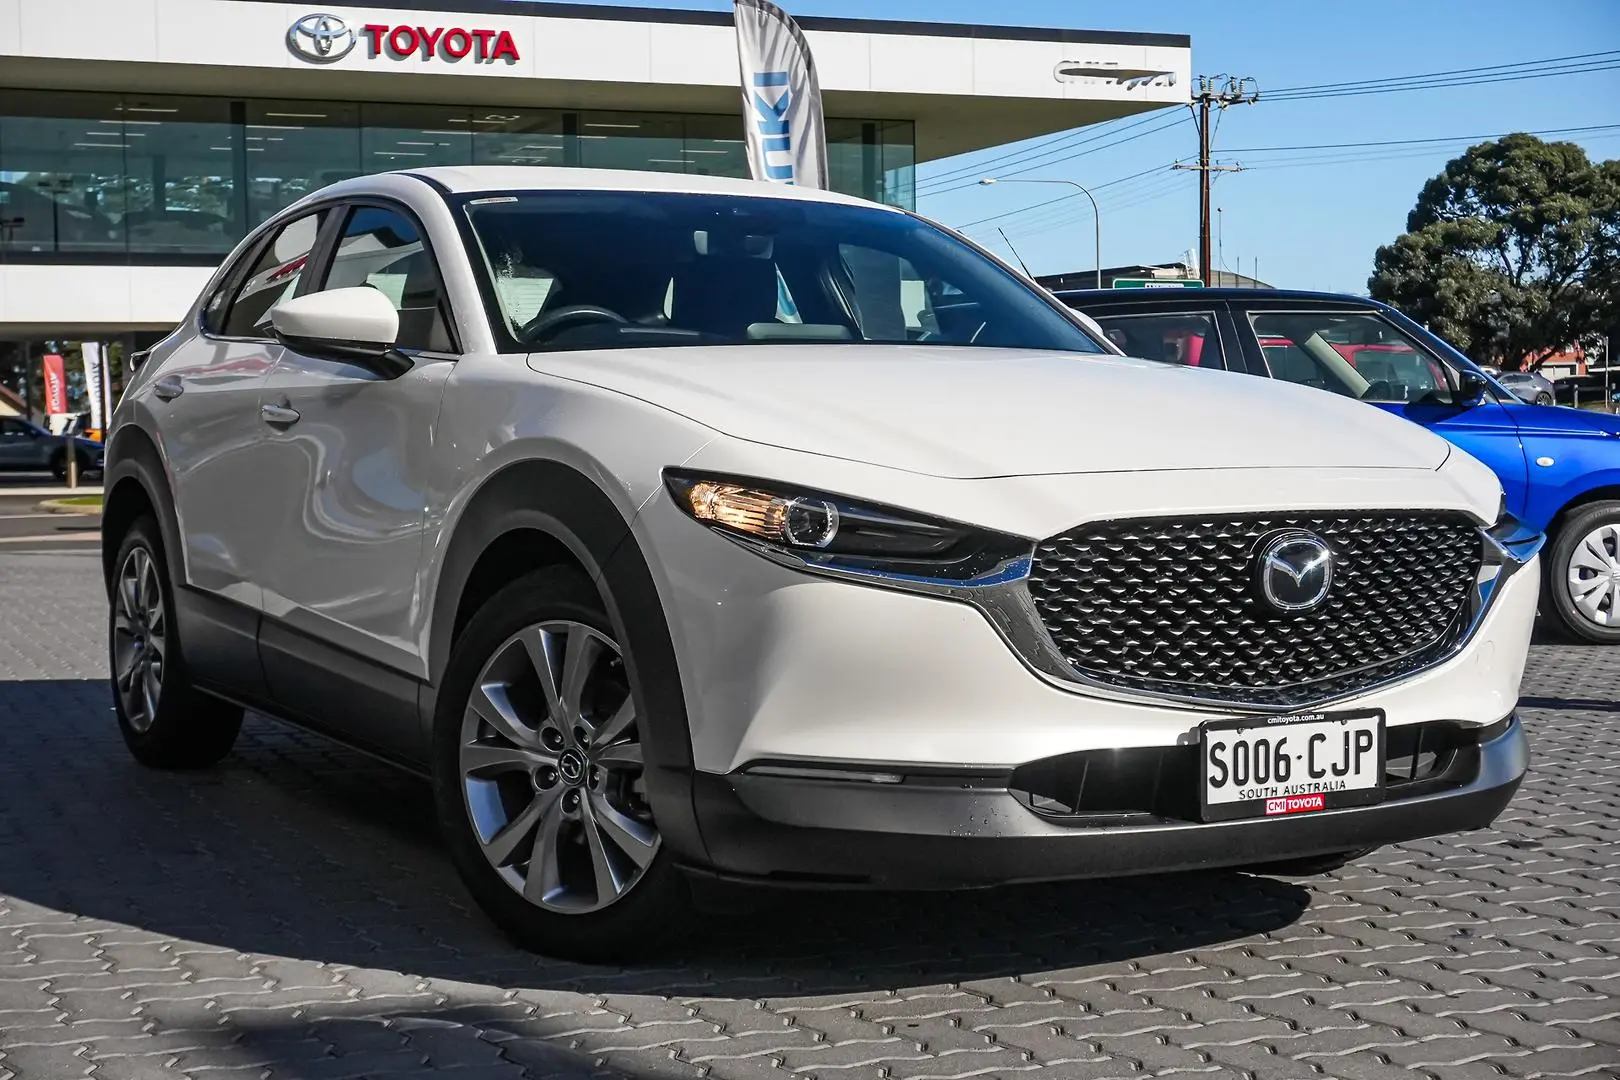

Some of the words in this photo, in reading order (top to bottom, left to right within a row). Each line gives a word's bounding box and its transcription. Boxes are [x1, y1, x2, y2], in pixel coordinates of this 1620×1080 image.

[365, 24, 520, 61] TOYOTA
[1267, 714, 1325, 724] cmitoyota.com.au
[1239, 787, 1278, 799] SOUTH
[1283, 780, 1346, 795] AUSTRALIA
[1268, 800, 1286, 811] CMI
[1287, 797, 1322, 809] TOYOTA
